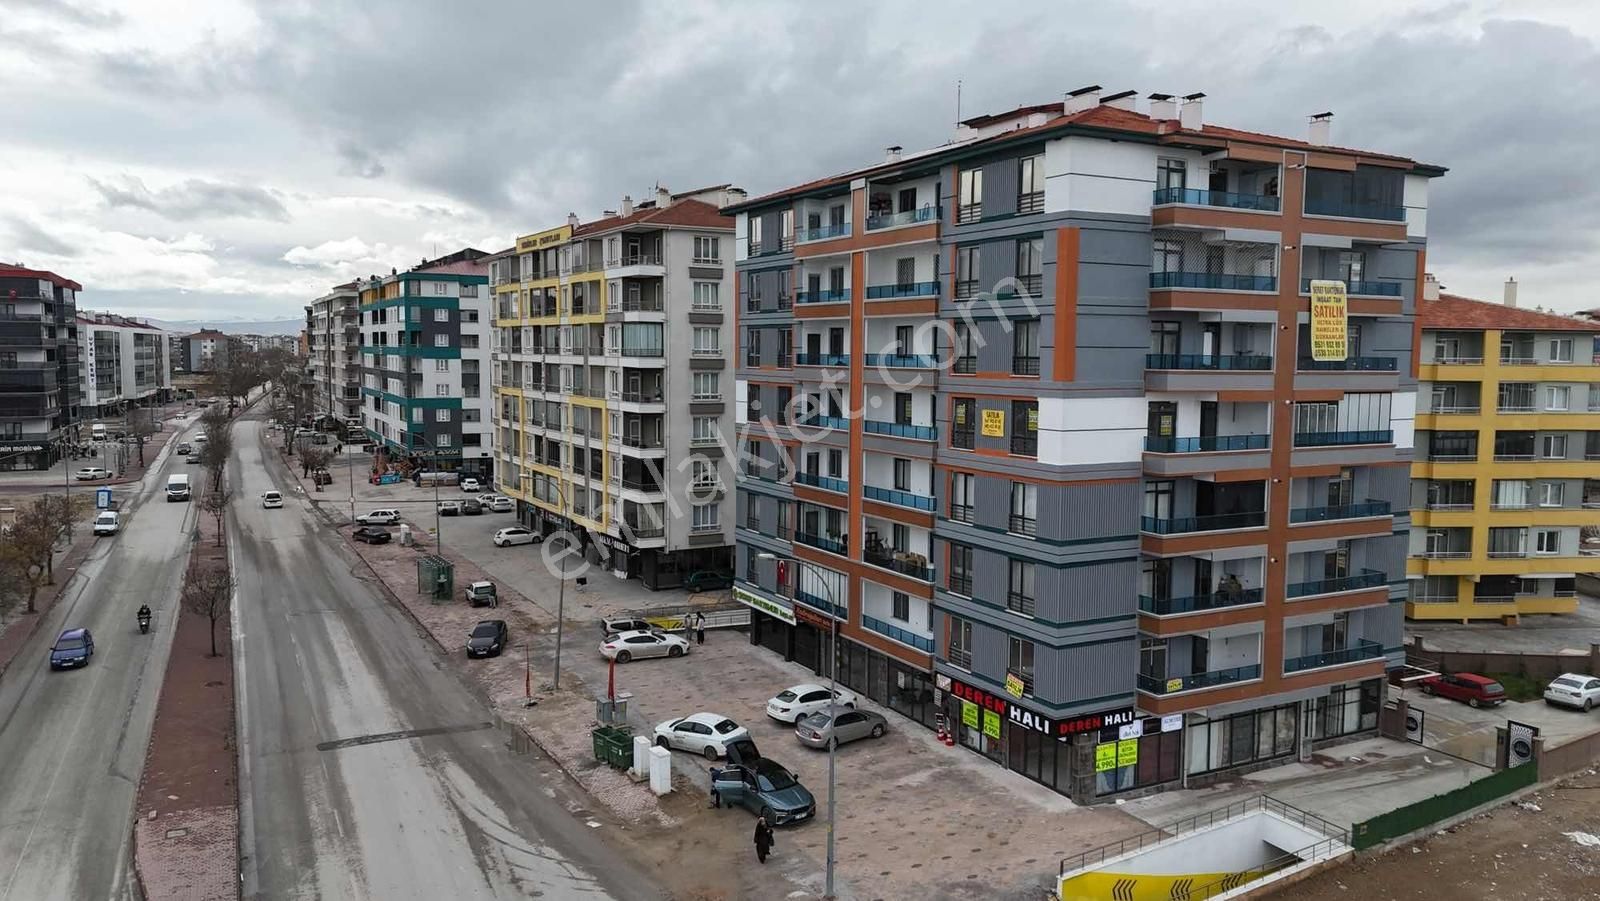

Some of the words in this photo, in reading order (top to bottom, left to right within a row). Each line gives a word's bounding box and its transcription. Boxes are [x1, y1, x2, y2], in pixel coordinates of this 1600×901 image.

[1314, 305, 1344, 318] SATILIK
[954, 681, 1006, 714] DEREN
[1010, 705, 1050, 735] HALI
[1059, 717, 1102, 734] DEREN
[1104, 711, 1133, 726] HALI
